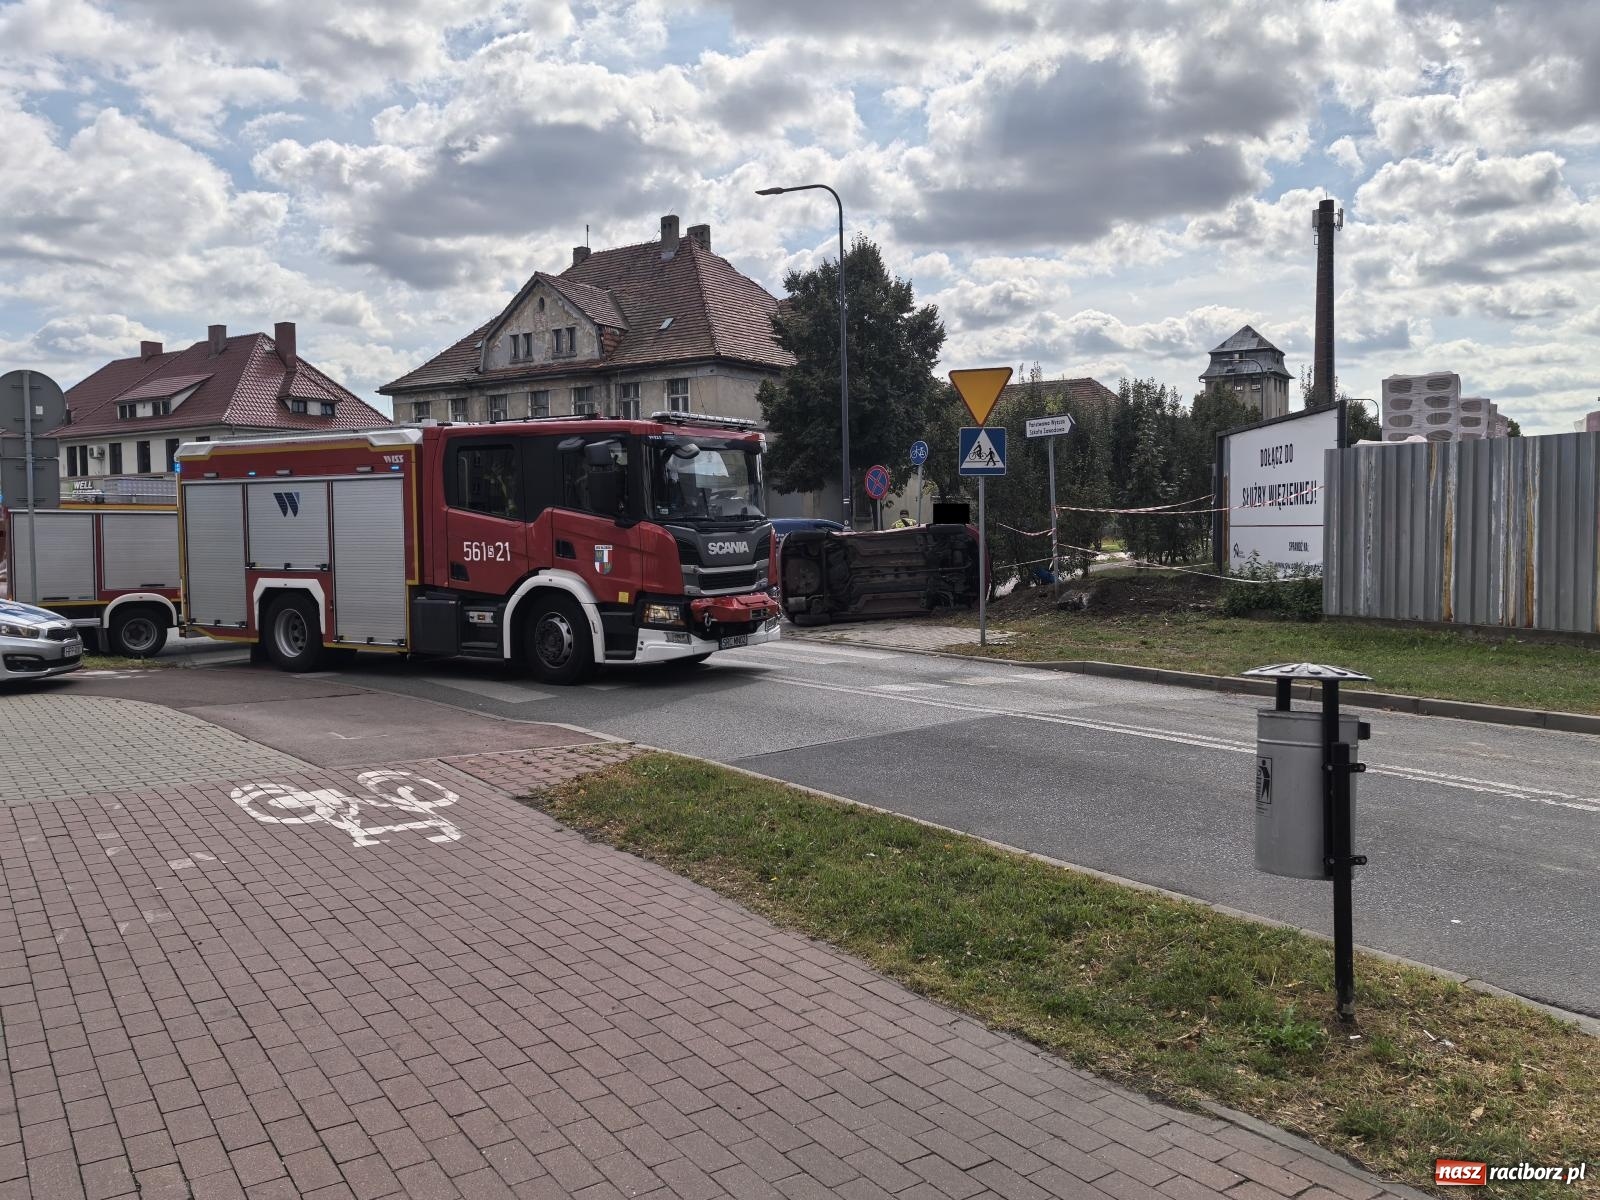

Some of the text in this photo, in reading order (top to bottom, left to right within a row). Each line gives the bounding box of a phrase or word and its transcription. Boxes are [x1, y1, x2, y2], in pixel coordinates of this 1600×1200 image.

[1260, 443, 1294, 469] DOŁĄCZ DO
[73, 480, 93, 490] WELL
[1242, 480, 1317, 511] SŁUŻBY WIĘZIENNEJ!
[707, 541, 750, 555] SCANIA
